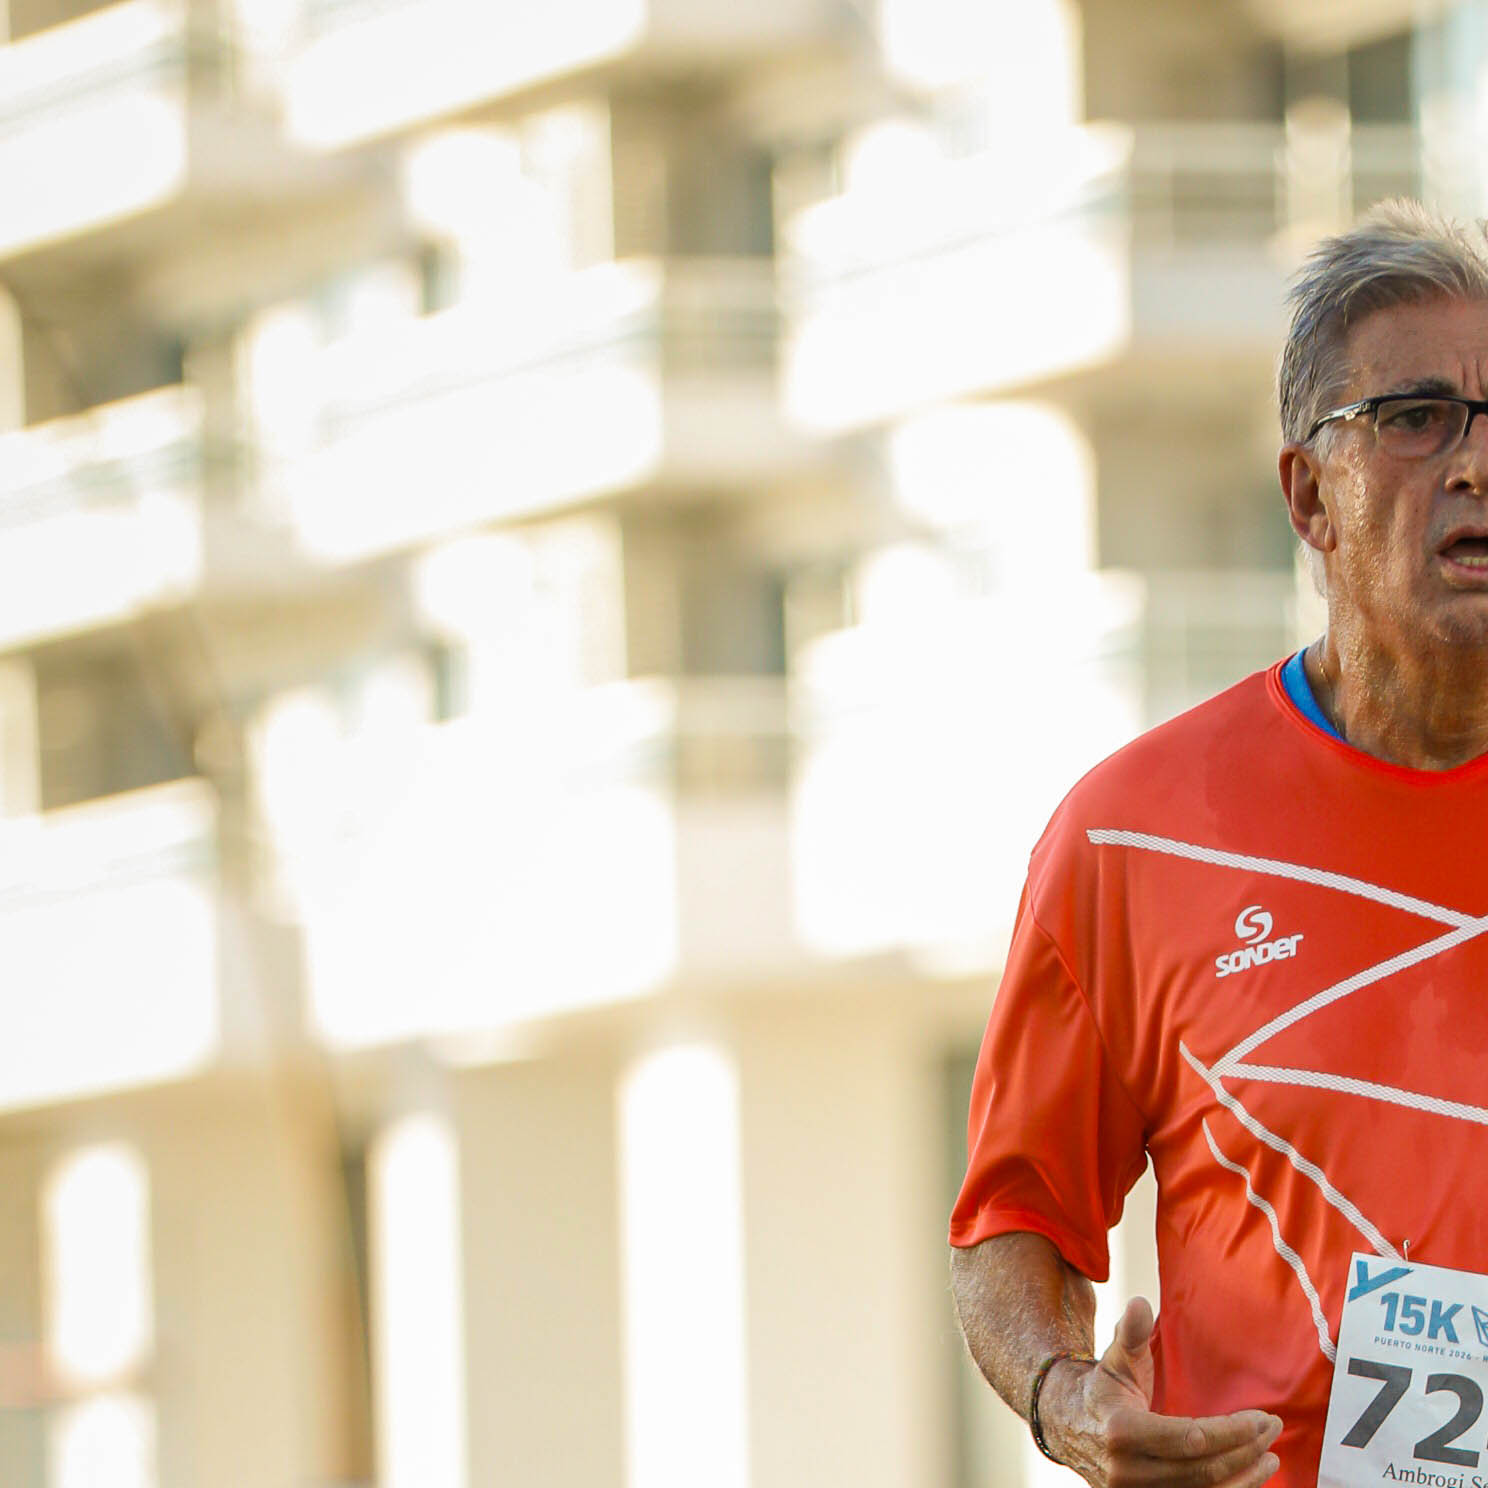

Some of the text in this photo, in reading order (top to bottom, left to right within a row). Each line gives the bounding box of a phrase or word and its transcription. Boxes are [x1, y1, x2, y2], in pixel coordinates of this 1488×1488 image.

[1380, 1291, 1465, 1344] 15K
[1374, 1335, 1413, 1350] PUERTO
[1414, 1343, 1446, 1356] NORTE
[1448, 1349, 1473, 1361] 2026
